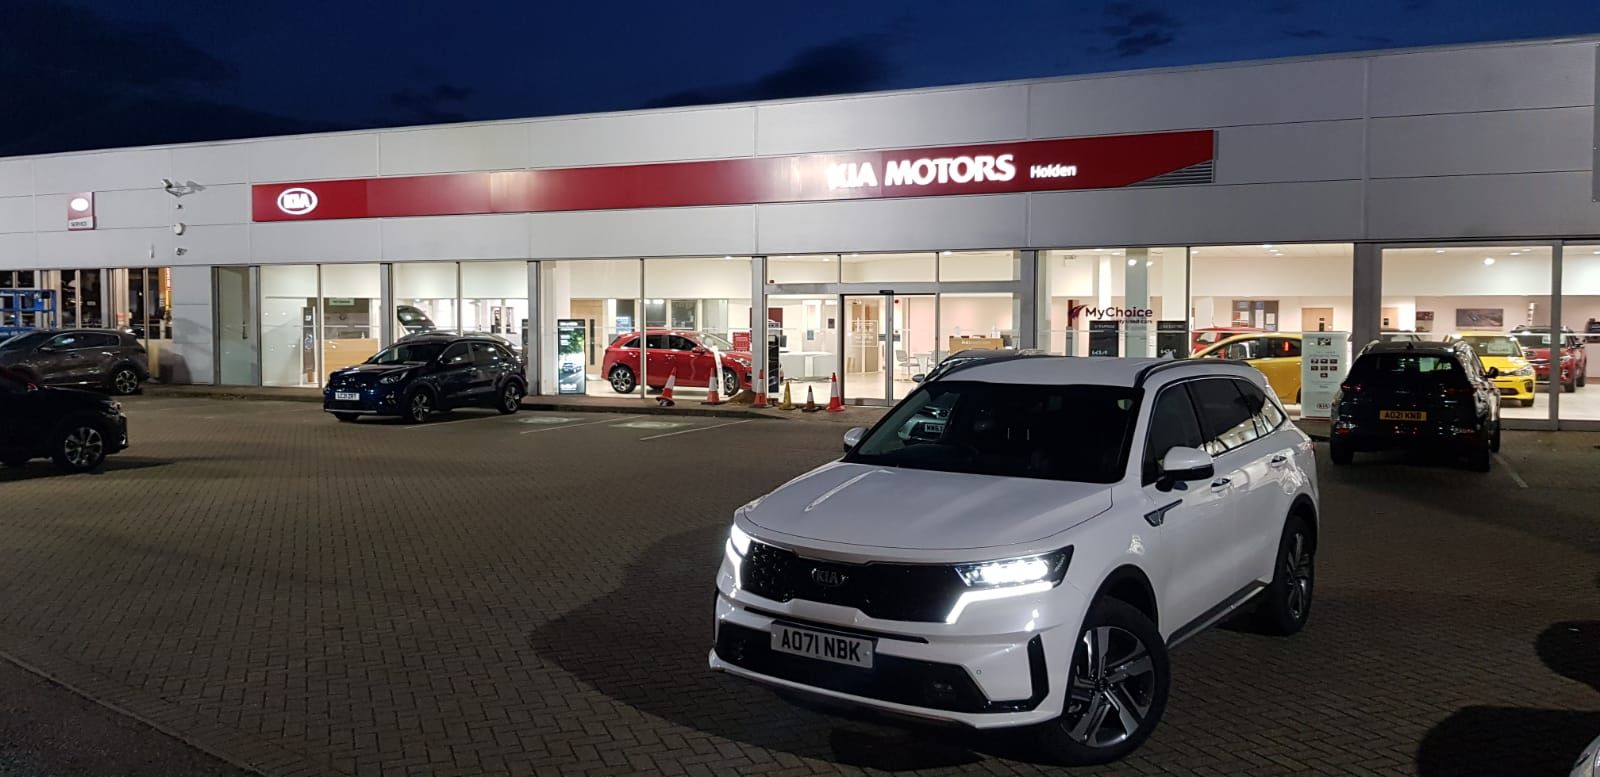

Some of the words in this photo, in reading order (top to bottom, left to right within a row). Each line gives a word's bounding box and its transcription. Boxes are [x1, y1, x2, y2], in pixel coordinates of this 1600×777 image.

[826, 162, 878, 188] KIA
[884, 154, 1016, 186] MOTORS
[1030, 163, 1077, 179] Holden
[1085, 306, 1153, 320] MyChoice
[815, 569, 840, 585] KIA
[824, 636, 861, 662] NBK
